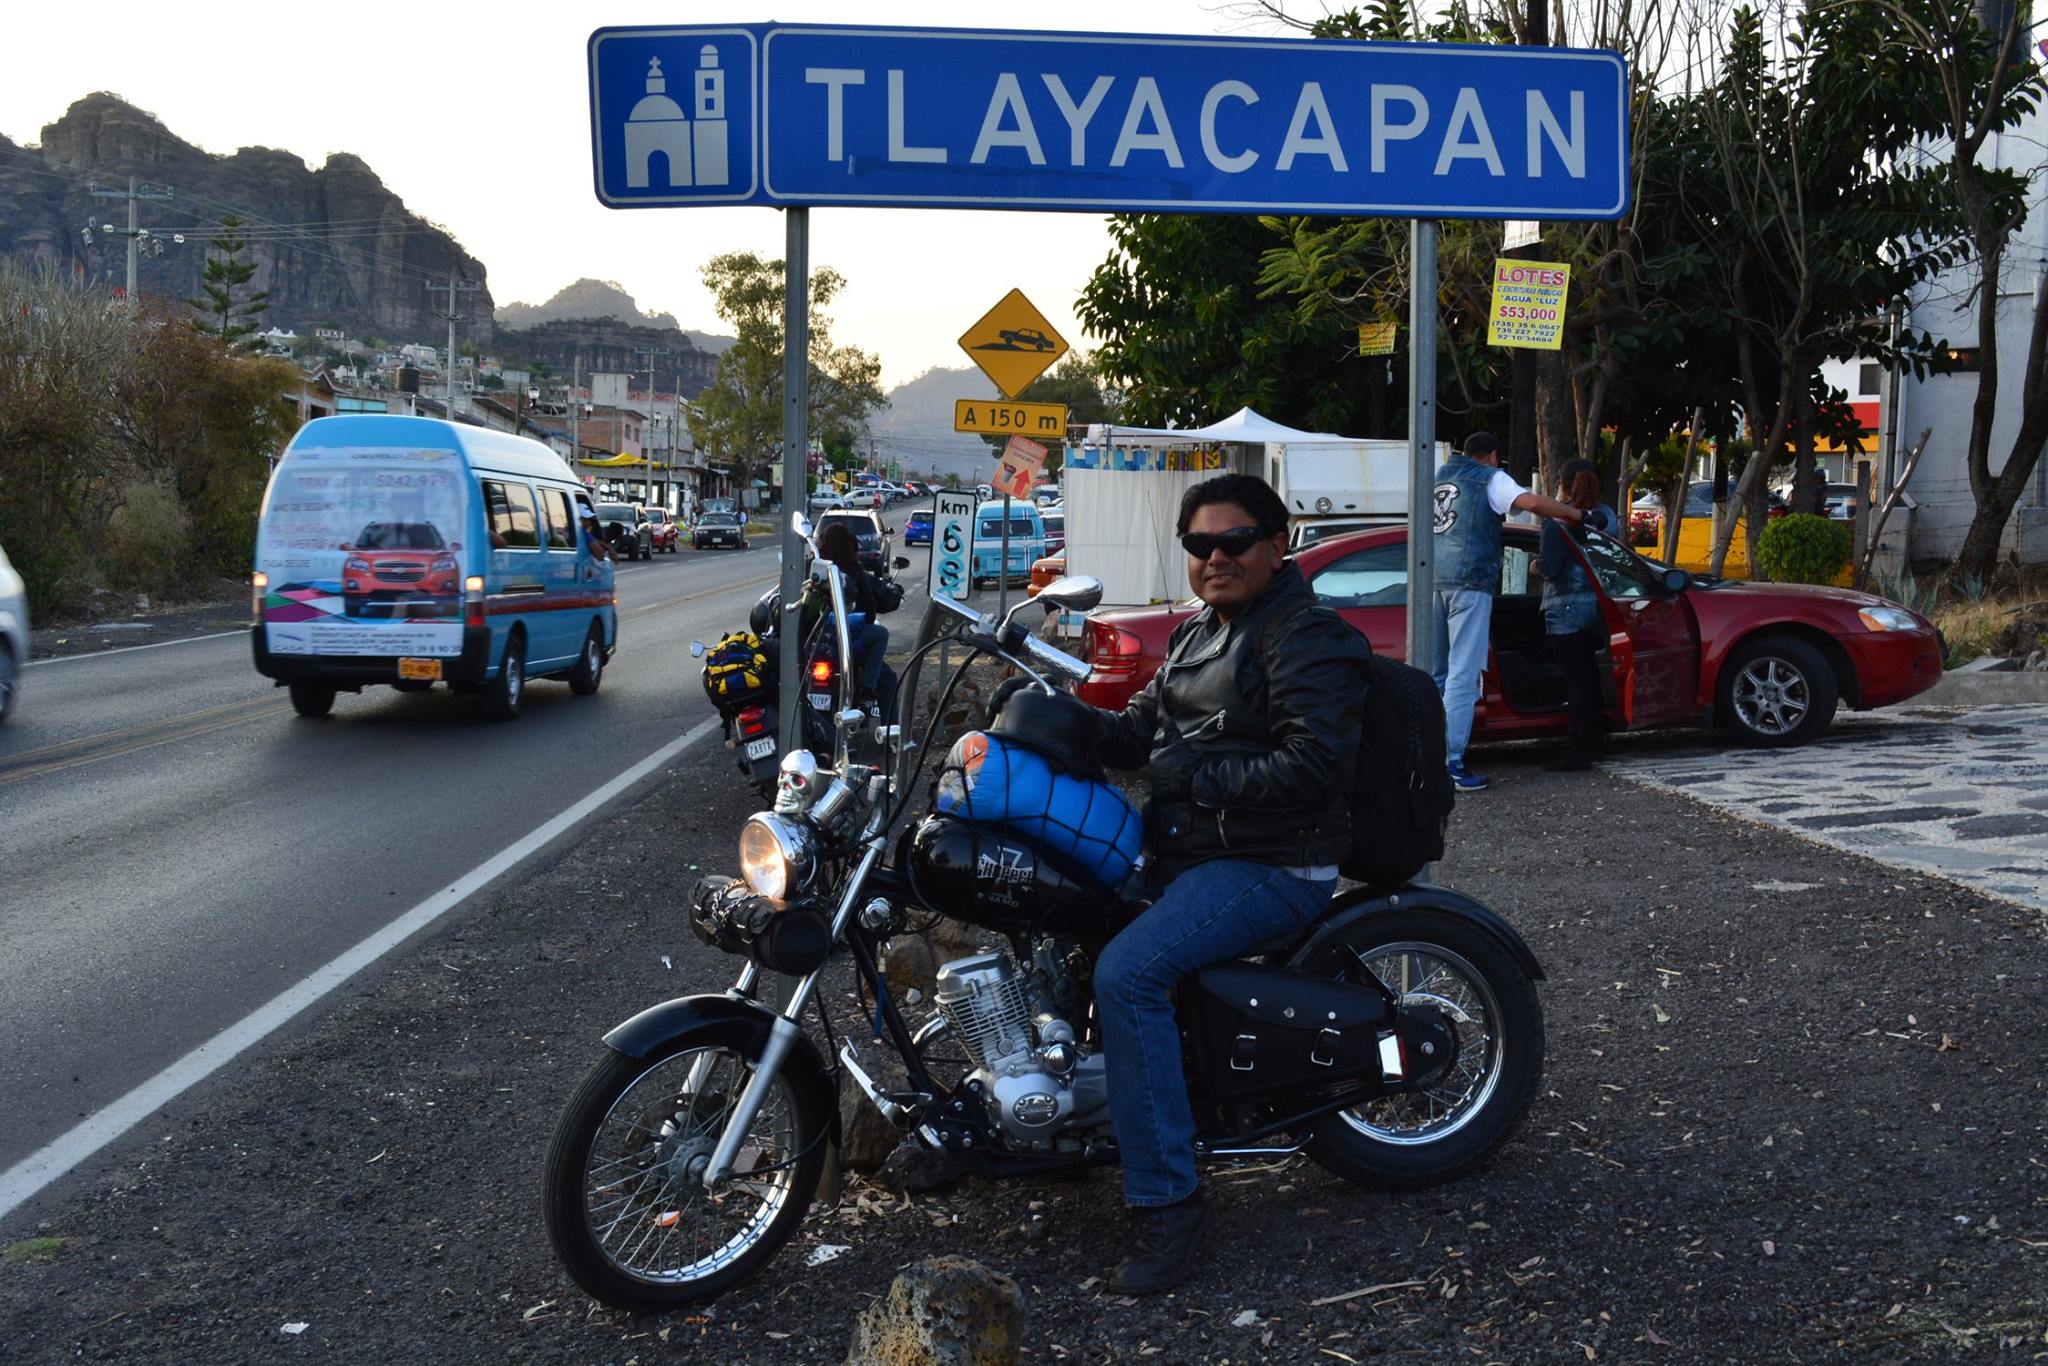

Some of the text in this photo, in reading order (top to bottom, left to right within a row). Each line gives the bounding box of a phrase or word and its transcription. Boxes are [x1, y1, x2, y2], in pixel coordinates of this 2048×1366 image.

[803, 66, 1588, 180] TLAYACAPAN
[1498, 266, 1566, 288] LOTES
[1499, 306, 1557, 320] $53,000
[963, 407, 1058, 430] A 150 m
[941, 499, 969, 515] km
